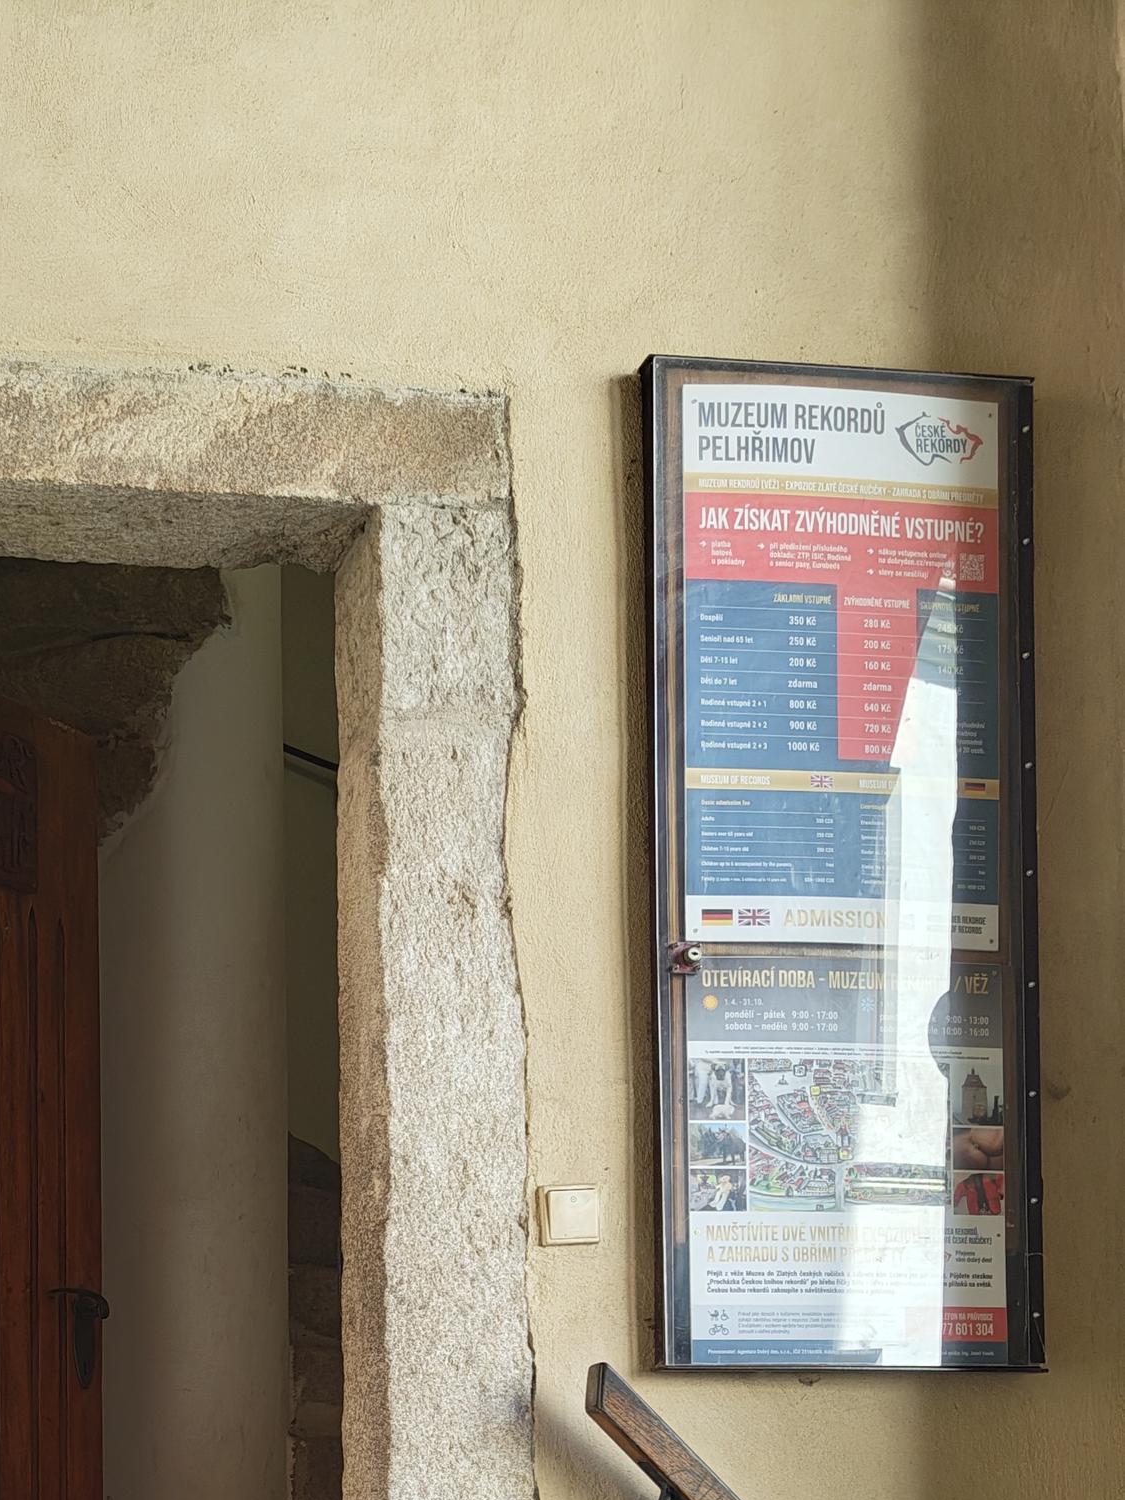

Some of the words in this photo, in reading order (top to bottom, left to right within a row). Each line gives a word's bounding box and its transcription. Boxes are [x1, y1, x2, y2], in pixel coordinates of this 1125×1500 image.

[698, 401, 787, 429] MUZEUM
[794, 401, 885, 435] REKORDŮ
[914, 422, 946, 438] ČESKÉ
[698, 430, 816, 464] PELHŘIMOV
[915, 438, 968, 454] REKORDY
[698, 478, 728, 488] MUZEUM
[729, 478, 760, 489] REKORDŮ
[785, 480, 816, 491] EXPOZICE
[818, 480, 837, 492] ZLATÉ
[838, 481, 860, 493] ČESKÉ
[860, 483, 887, 495] RUČIČKY
[892, 487, 922, 498] ZAHRADA
[922, 489, 927, 499] S
[699, 506, 730, 529] JAK
[734, 503, 791, 532] ZÍSKAT
[794, 506, 901, 538] ZVÝHODNĚNÉ
[905, 517, 984, 544] VSTUPNÉ?
[769, 542, 779, 551] při
[878, 548, 896, 557] nákup
[716, 558, 745, 568] pokladny
[775, 560, 795, 568] senior
[773, 593, 804, 604] ZÁKLADNÍ
[804, 595, 832, 605] VSTUPNÉ
[843, 596, 883, 608] ZVÝHODNĚNÉ
[884, 598, 910, 609] VSTUPNÉ
[700, 612, 724, 622] Dospělí
[789, 616, 804, 626] 350
[806, 615, 817, 626] Kč
[863, 619, 879, 629] 280
[881, 619, 891, 629] Kč
[700, 634, 723, 643] Senioři
[723, 635, 735, 643] nad
[789, 636, 804, 646] 250
[806, 636, 817, 647] Kč
[863, 640, 879, 650] 200
[881, 640, 891, 650] Kč
[938, 645, 952, 654] 175
[700, 655, 713, 664] Děti
[729, 656, 738, 665] let
[789, 657, 804, 667] 200
[806, 657, 817, 668] Kč
[864, 661, 879, 671] 160
[881, 661, 891, 671] Kč
[700, 676, 714, 685] Děti
[714, 677, 722, 685] do
[729, 678, 738, 686] let
[788, 679, 818, 689] zdarma
[863, 682, 892, 692] zdarma
[700, 698, 725, 707] Rodinné
[727, 699, 751, 708] vstupné
[752, 700, 757, 708] 2
[789, 700, 805, 709] 800
[806, 700, 817, 710] Kč
[864, 703, 879, 713] 640
[881, 703, 892, 713] Kč
[700, 719, 725, 728] Rodinné
[727, 720, 751, 729] vstupné
[752, 721, 757, 729] 2
[763, 721, 768, 729] 2
[789, 720, 805, 730] 900
[806, 720, 817, 731] Kč
[864, 723, 880, 733] 720
[881, 724, 892, 734] Kč
[700, 741, 725, 749] Rodinné
[727, 741, 751, 751] vstupné
[752, 742, 757, 750] 2
[763, 742, 768, 750] 3
[787, 741, 808, 751] 1000
[809, 741, 820, 752] Kč
[864, 744, 880, 754] 800
[881, 744, 892, 755] Kč
[700, 775, 730, 785] MUSEUM
[731, 775, 740, 785] OF
[740, 775, 771, 786] RECORDS
[859, 779, 887, 789] MUSEUM
[783, 908, 890, 930] ADMISSION
[962, 915, 987, 926] REKORDE
[958, 926, 983, 935] RECORDS
[702, 966, 776, 988] OTEVÍRACÍ
[778, 969, 816, 989] DOBA
[828, 970, 885, 991] MUZEUM
[964, 972, 989, 995] VĚŽ
[724, 1009, 755, 1020] pondělí
[763, 1009, 786, 1020] pátek
[791, 1010, 809, 1020] 9:00
[816, 1011, 839, 1020] 17:00
[946, 1016, 962, 1025] 9:00
[969, 1016, 990, 1026] 13:00
[724, 1021, 752, 1031] sobota
[761, 1021, 788, 1031] neděle
[791, 1022, 809, 1032] 9:00
[816, 1022, 839, 1032] 17:00
[941, 1026, 963, 1036] 10:00
[969, 1028, 990, 1037] 16:00
[706, 1222, 779, 1242] NAVŠTÍVÍTE
[782, 1223, 806, 1242] DVĚ
[707, 1246, 715, 1263] A
[718, 1246, 778, 1263] ZAHRADU
[781, 1246, 789, 1263] S
[793, 1243, 837, 1263] OBŘÍMI
[776, 1270, 798, 1278] Zlatých
[799, 1270, 823, 1278] českých
[741, 1277, 763, 1286] Českou
[764, 1278, 784, 1286] knihou
[706, 1286, 729, 1294] Českou
[729, 1286, 746, 1294] knihu
[747, 1286, 770, 1294] rekordů
[771, 1286, 799, 1295] zakoupíte
[955, 1322, 973, 1336] 601
[975, 1323, 994, 1336] 304
